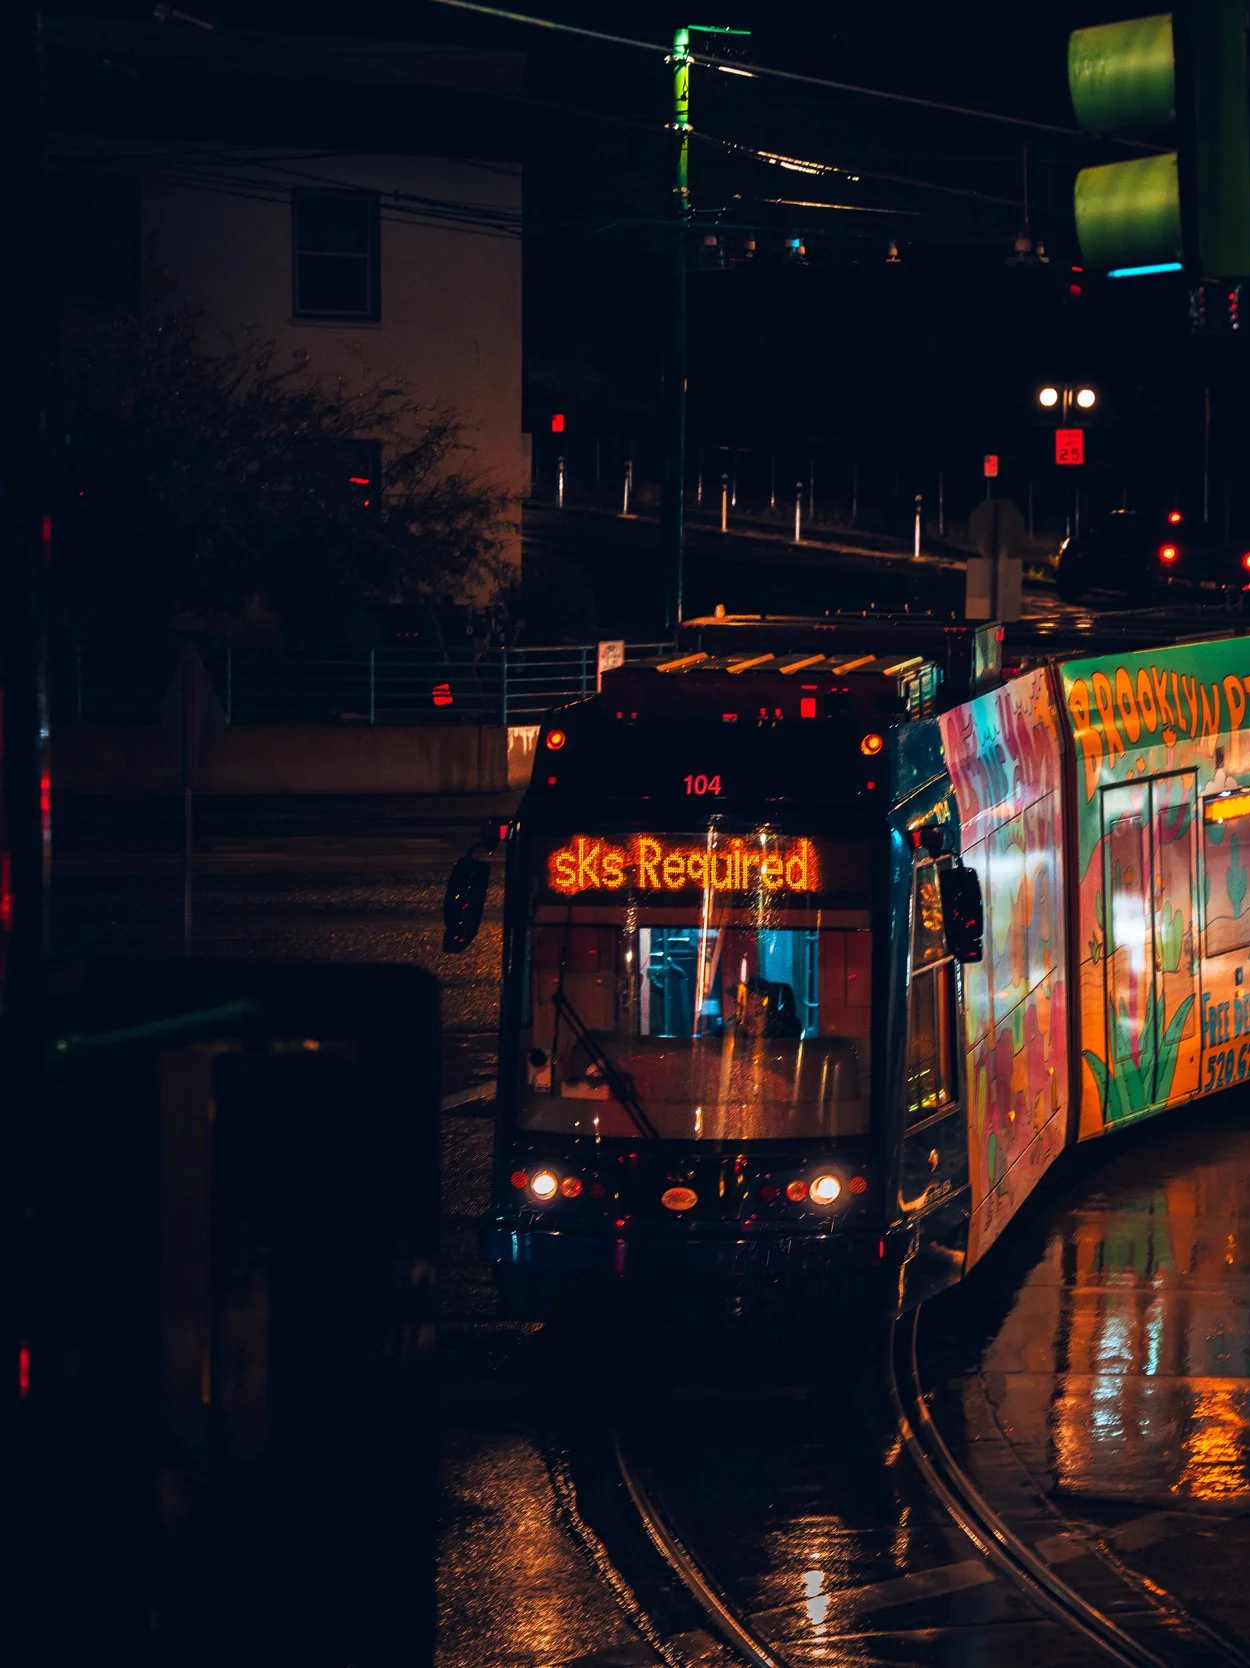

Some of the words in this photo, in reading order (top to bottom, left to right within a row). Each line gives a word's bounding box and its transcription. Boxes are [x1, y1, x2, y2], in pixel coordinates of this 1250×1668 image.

[1059, 447, 1081, 461] 25
[1067, 665, 1221, 797] BROOKLYN
[683, 774, 722, 796] 104
[638, 837, 809, 891] Required
